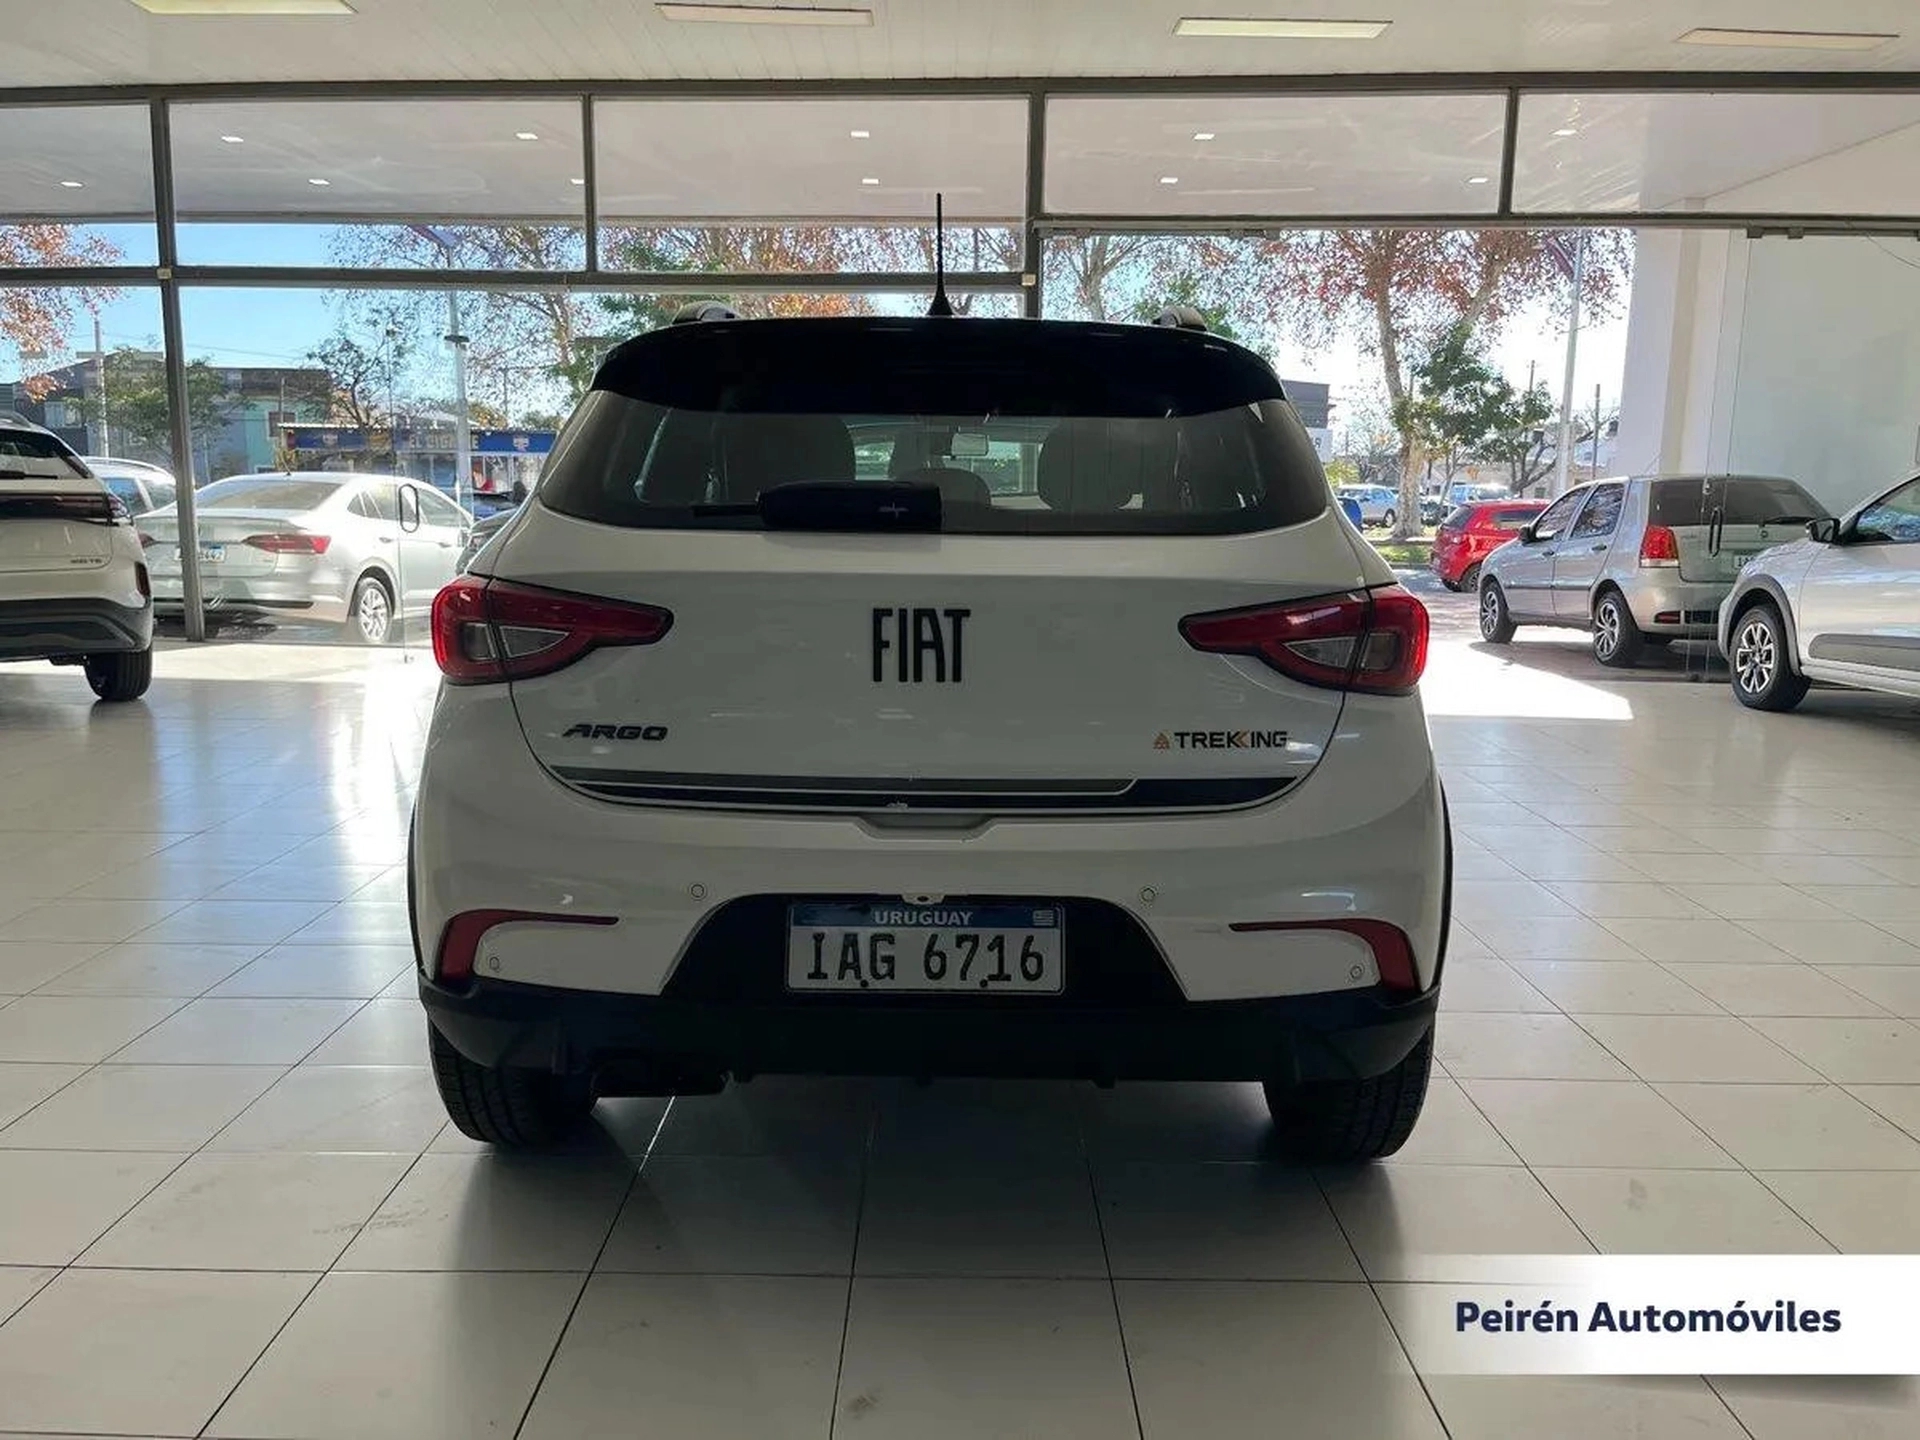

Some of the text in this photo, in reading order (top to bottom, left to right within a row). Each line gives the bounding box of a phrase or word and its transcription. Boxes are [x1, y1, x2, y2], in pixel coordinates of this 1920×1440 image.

[873, 608, 971, 682] FIAT
[562, 724, 668, 740] ARGO
[1174, 731, 1287, 748] TREKKING
[874, 911, 973, 925] URUGUAY
[807, 932, 1043, 982] IAG 6716
